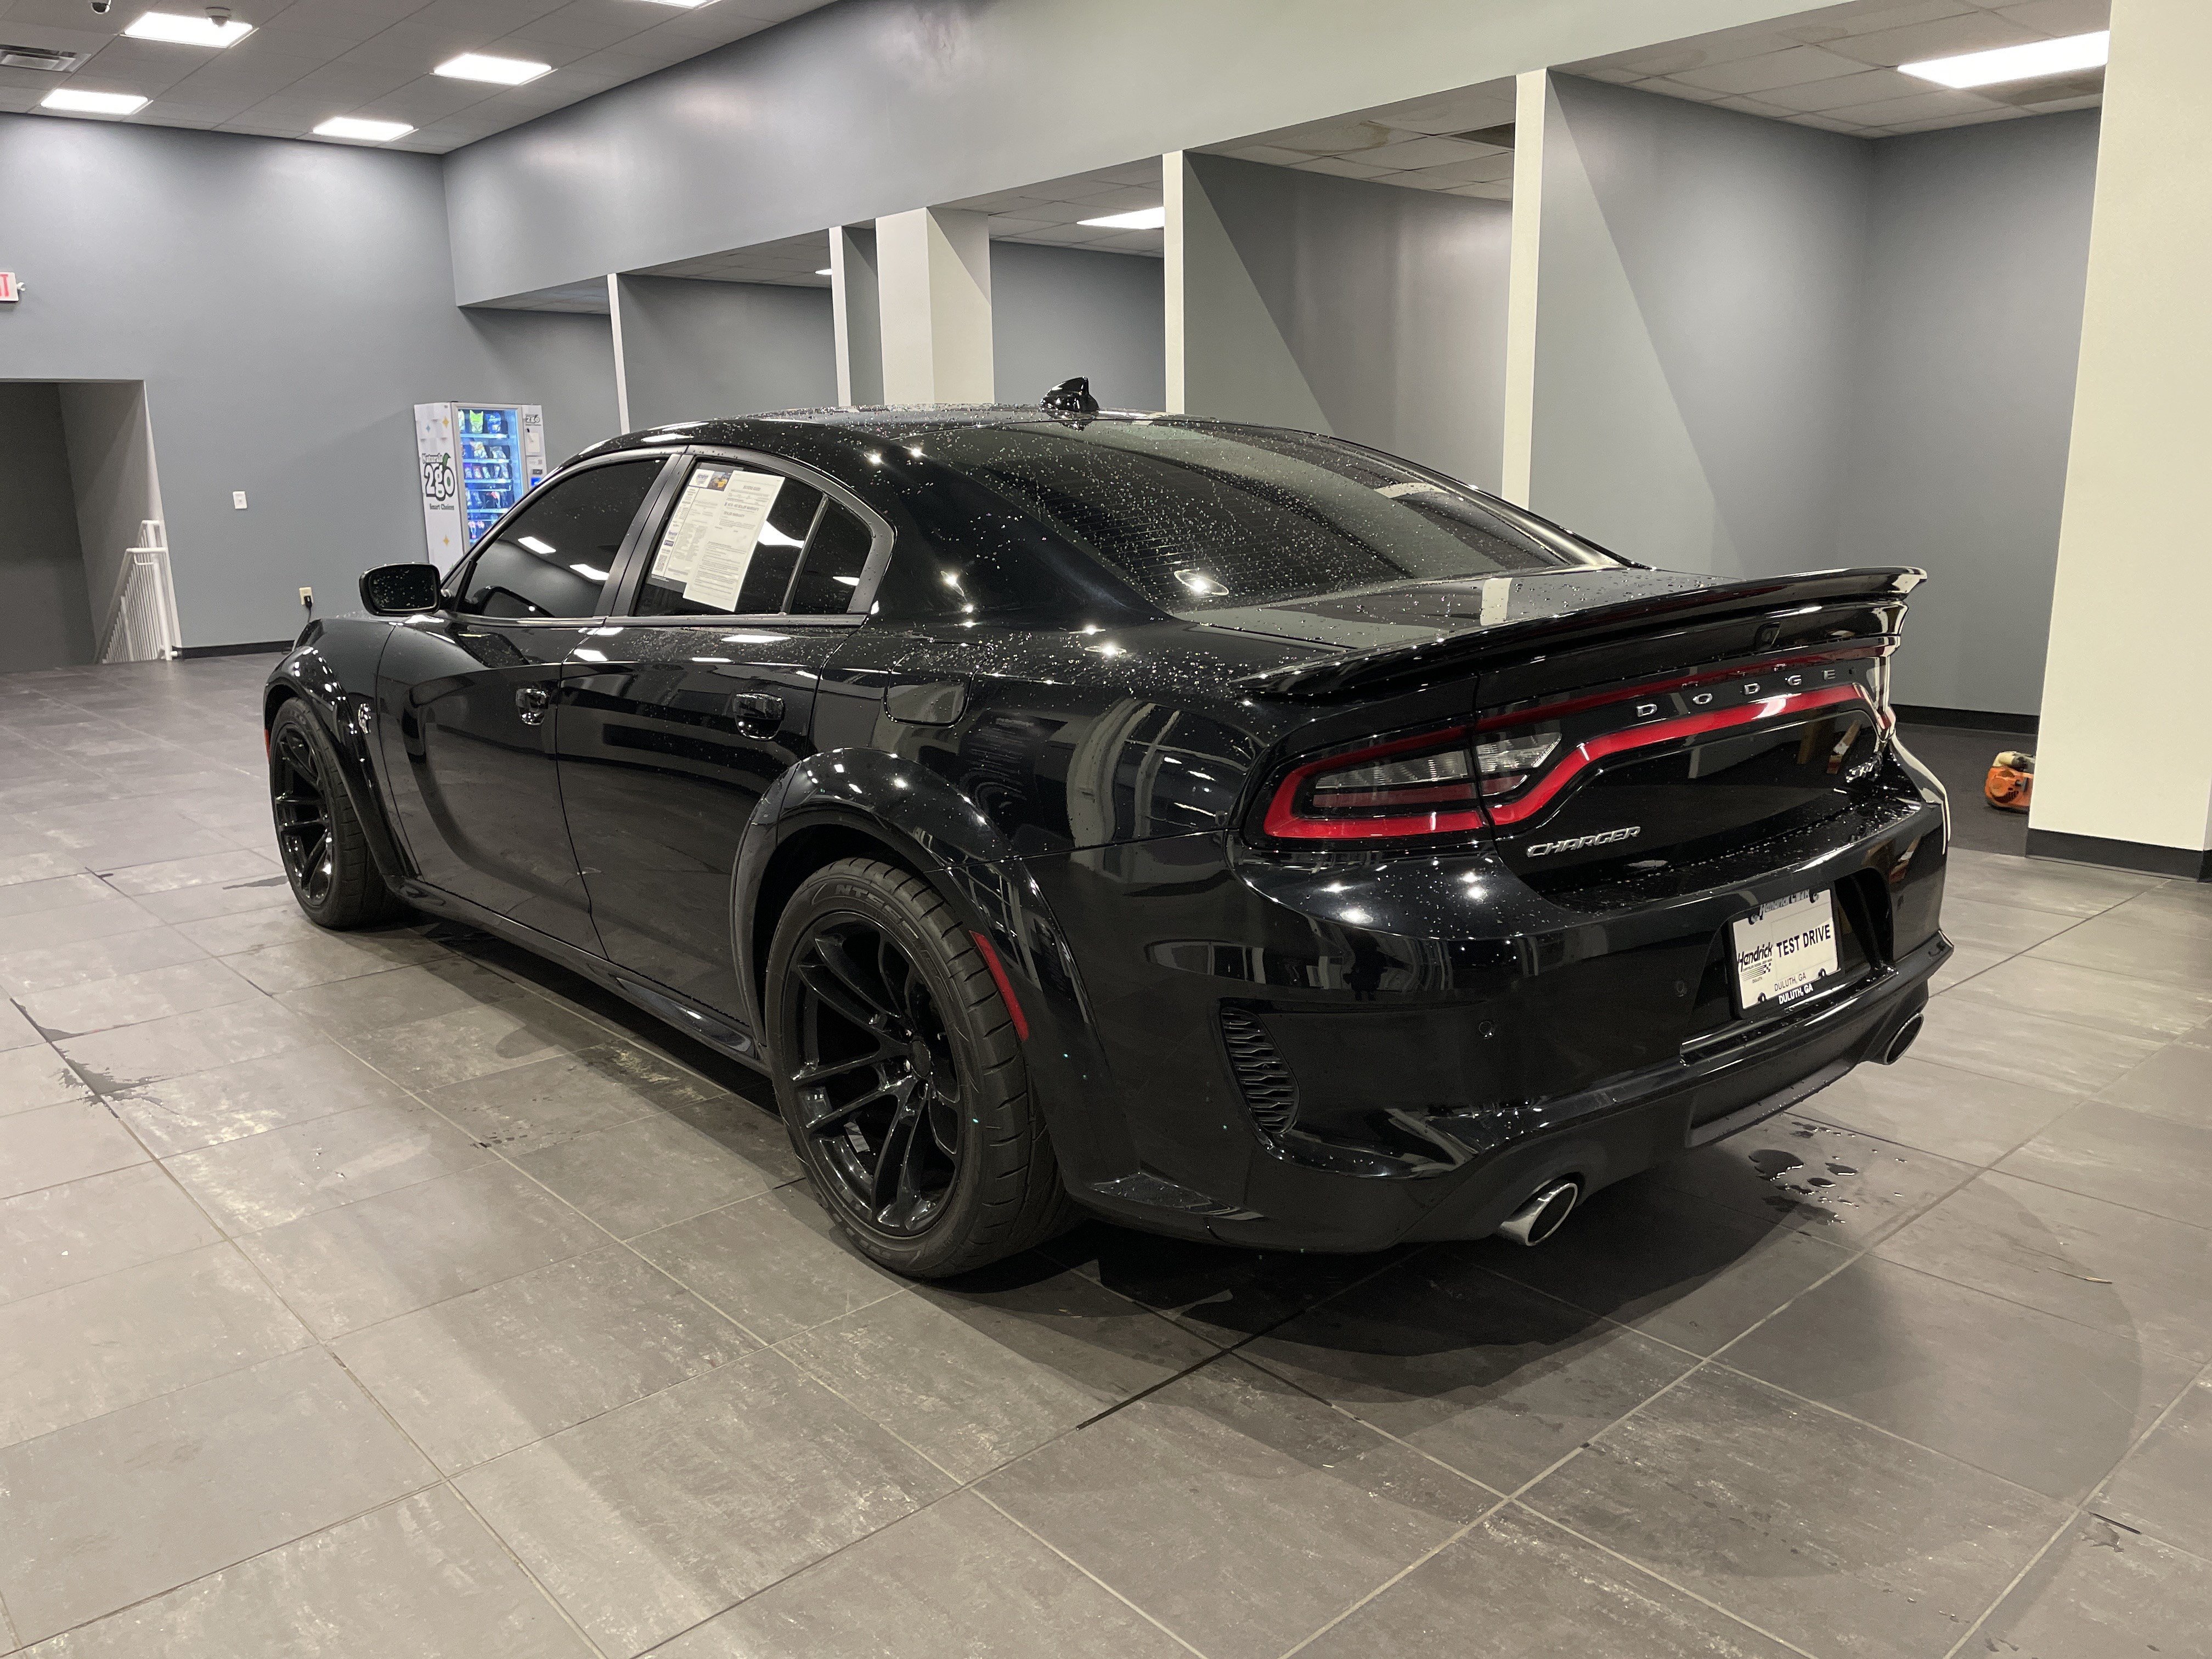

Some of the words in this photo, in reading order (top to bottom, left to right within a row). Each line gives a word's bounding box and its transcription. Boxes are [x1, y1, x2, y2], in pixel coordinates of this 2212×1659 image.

[1636, 669, 1836, 717] DODGE
[1526, 826, 1641, 857] CHARGER
[1776, 935, 1800, 958] TEST
[1803, 924, 1831, 948] DRIVE
[1737, 942, 1773, 973] Hendrick
[1774, 977, 1798, 991] DULUTH,
[1798, 972, 1807, 981] GA
[1778, 988, 1804, 1005] DULUTH,
[1804, 984, 1814, 994] GA
